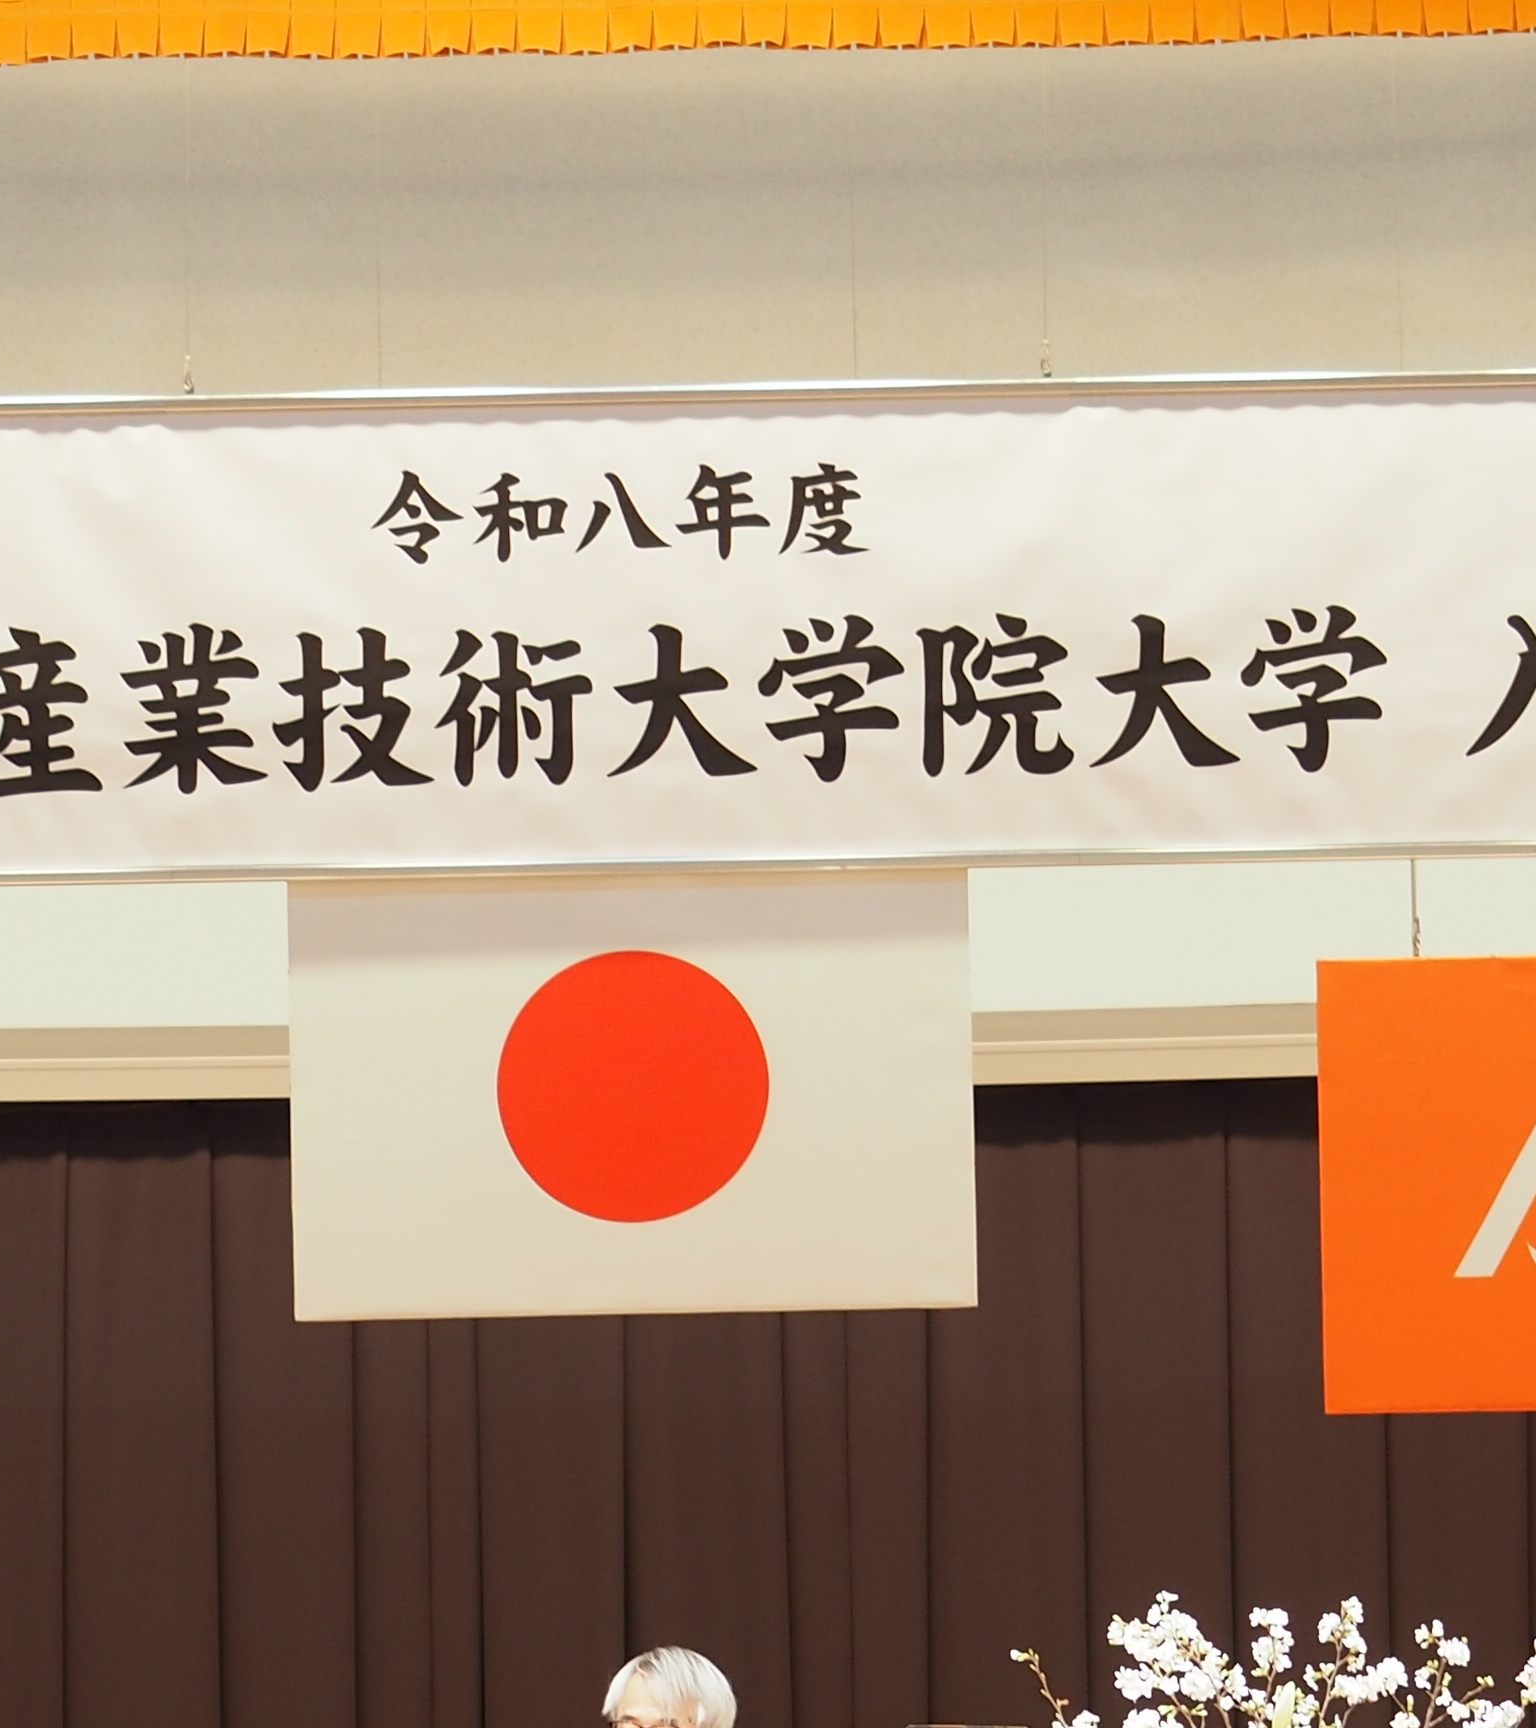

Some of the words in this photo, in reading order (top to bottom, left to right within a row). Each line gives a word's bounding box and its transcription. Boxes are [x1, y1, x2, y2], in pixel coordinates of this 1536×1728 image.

[372, 462, 869, 565] 令和八年度
